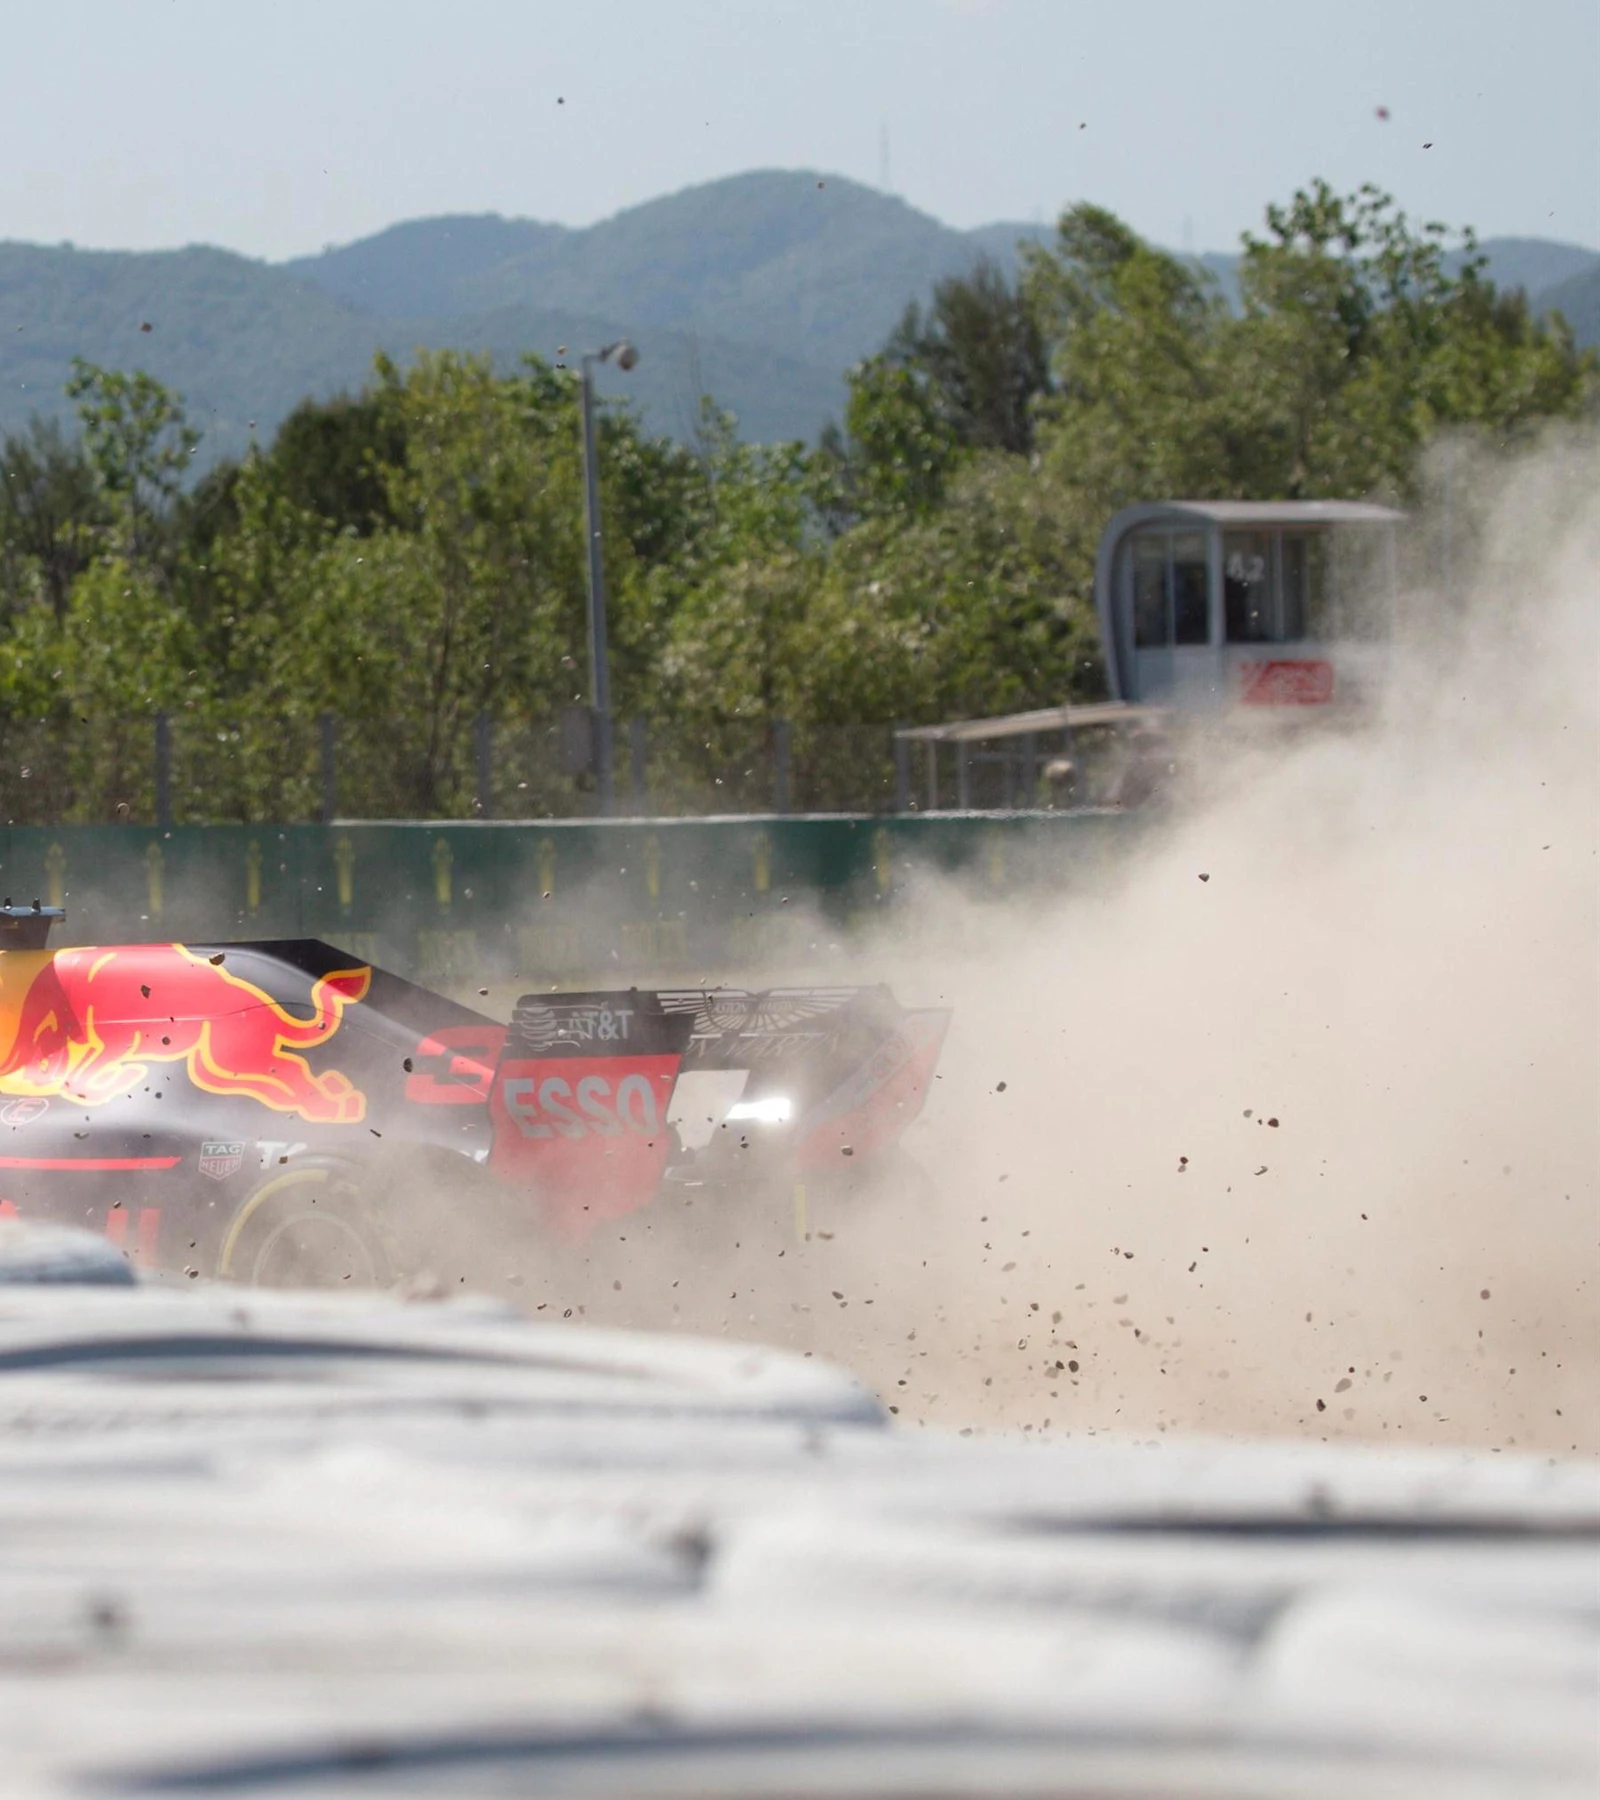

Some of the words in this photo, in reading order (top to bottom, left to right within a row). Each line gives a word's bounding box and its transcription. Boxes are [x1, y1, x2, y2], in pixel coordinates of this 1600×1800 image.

[563, 1010, 634, 1041] AT&T
[405, 1025, 507, 1104] 3
[205, 1145, 241, 1155] TAG
[201, 1160, 238, 1176] HEUER
